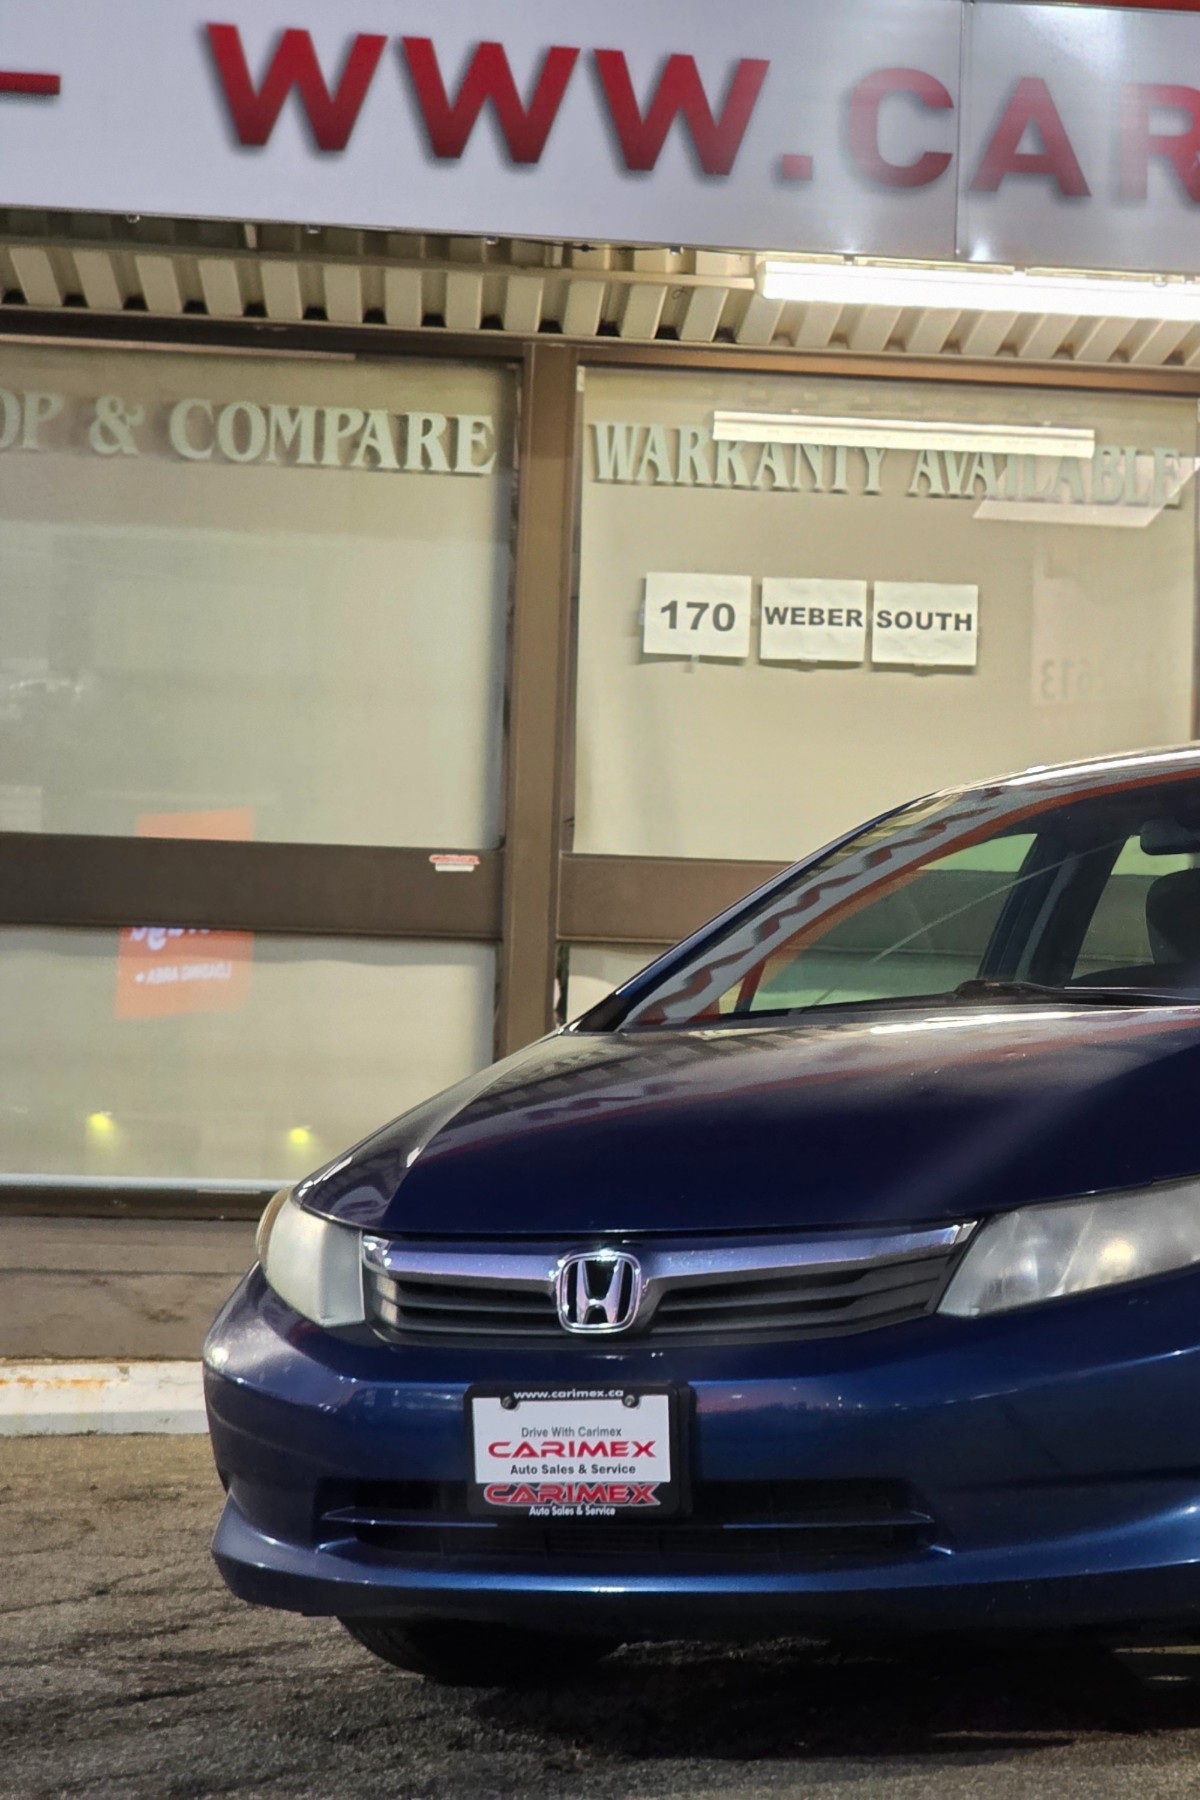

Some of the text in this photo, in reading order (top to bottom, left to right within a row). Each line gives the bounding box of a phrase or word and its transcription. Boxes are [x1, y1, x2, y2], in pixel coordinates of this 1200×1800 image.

[89, 394, 145, 456] &
[169, 397, 498, 475] COMPARE
[907, 444, 1183, 506] AVAILABLE
[660, 600, 736, 632] 170
[764, 605, 864, 628] WEBER
[876, 609, 973, 632] SOUTH
[513, 1388, 624, 1400] www.carimex.ca
[521, 1426, 622, 1438] Drive With Carimex
[488, 1440, 656, 1459] CARIMEX
[510, 1463, 636, 1475] Auto Sales & Service
[484, 1482, 660, 1506] CARIMEX
[529, 1505, 616, 1516] Auto Sales & Service
